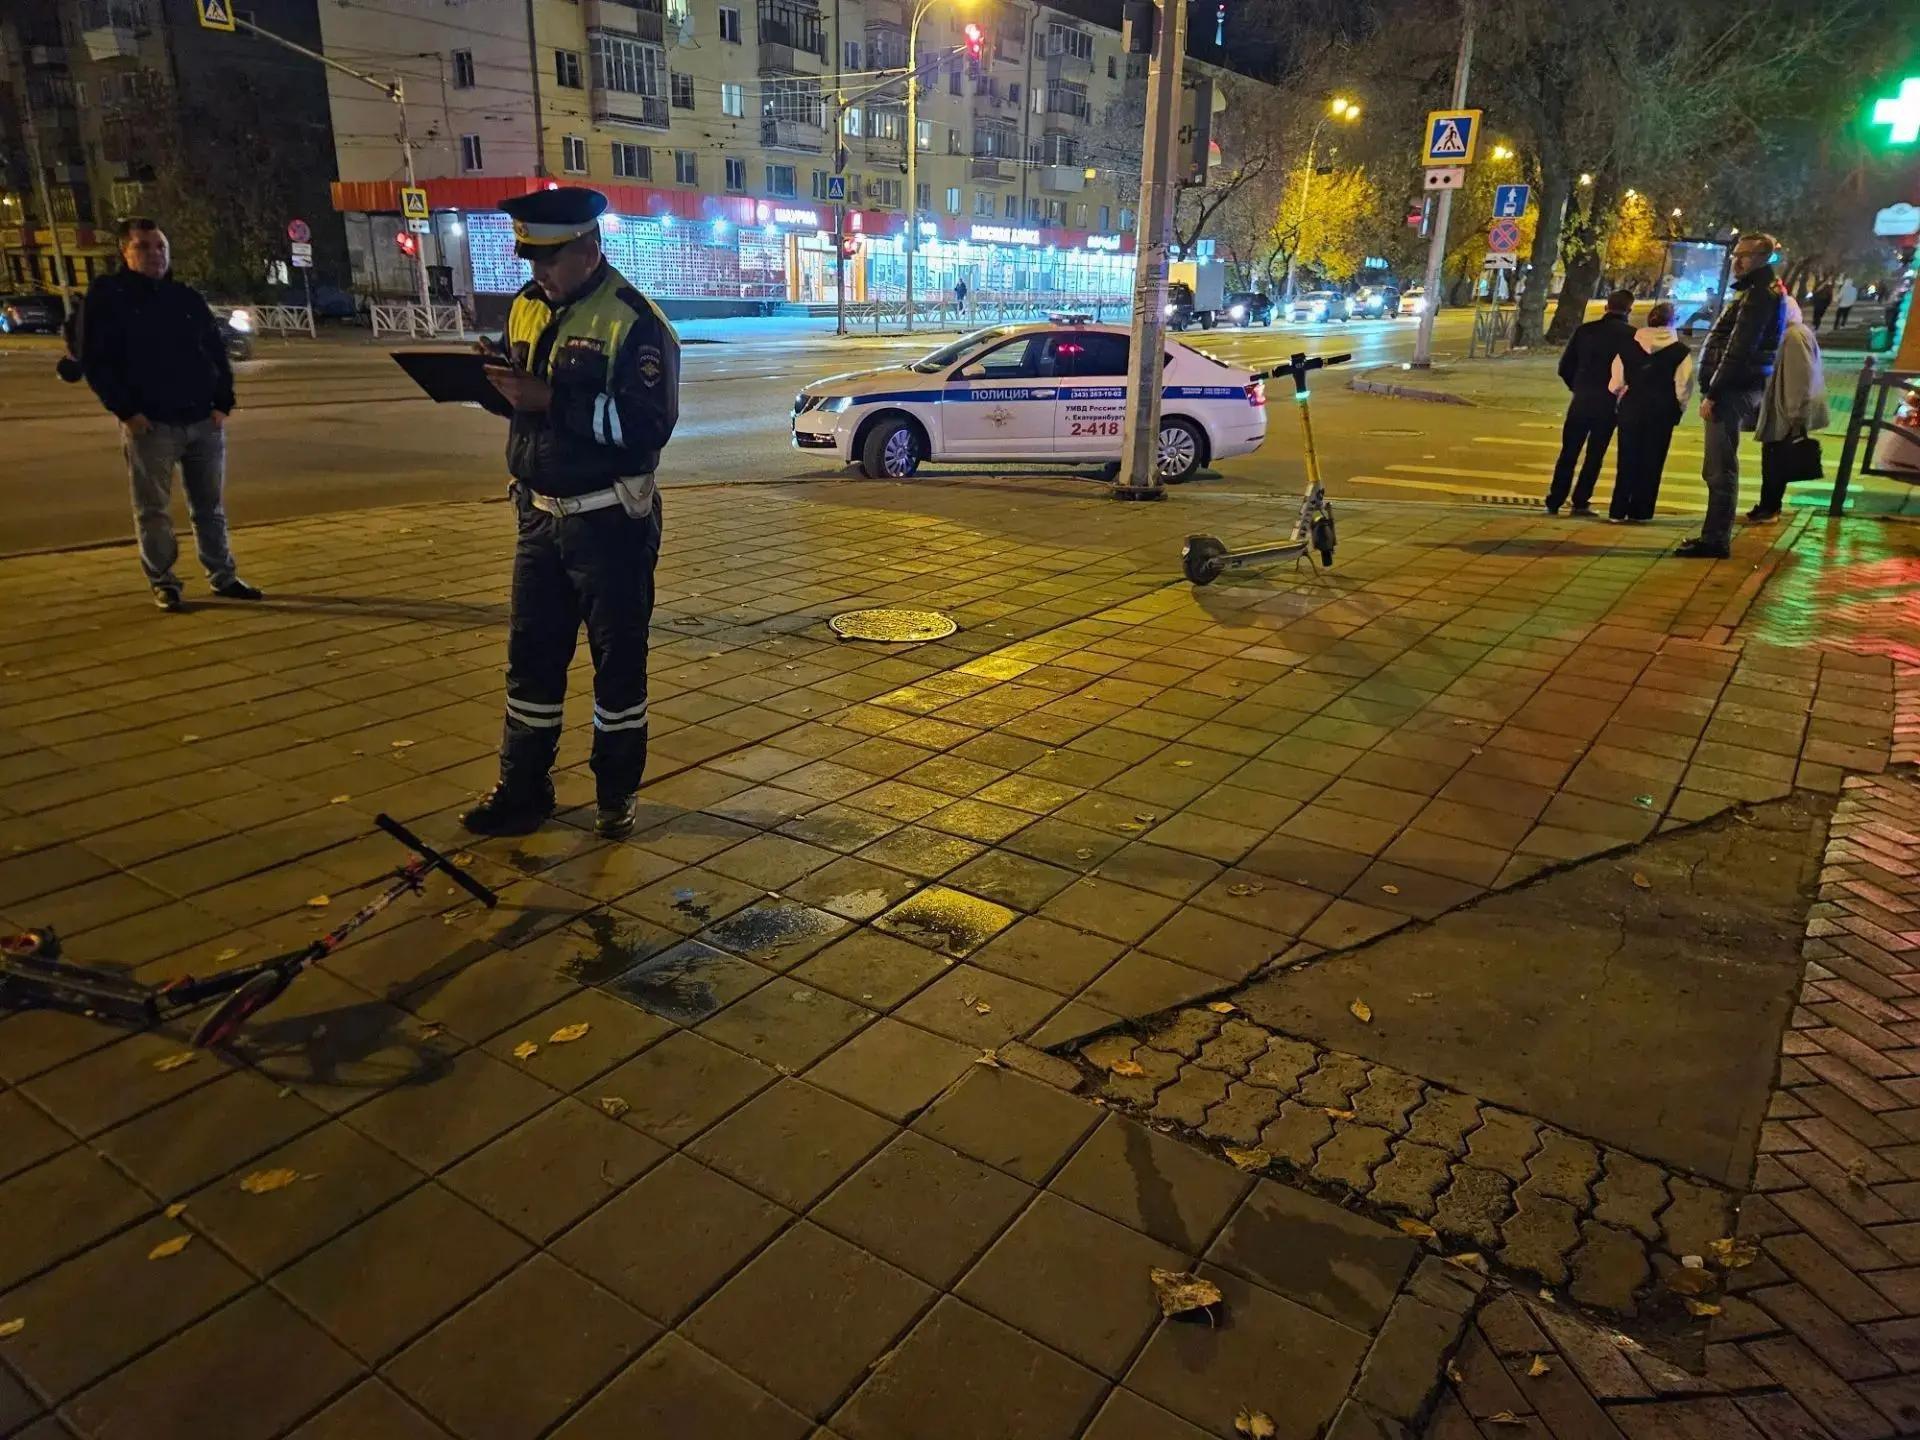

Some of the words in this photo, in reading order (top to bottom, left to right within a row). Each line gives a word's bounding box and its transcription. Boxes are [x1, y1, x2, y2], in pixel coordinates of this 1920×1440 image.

[775, 208, 818, 226] ШАУРМА
[971, 389, 1029, 401] ПОЛИЦИЯ
[1071, 422, 1119, 436] 2-418
